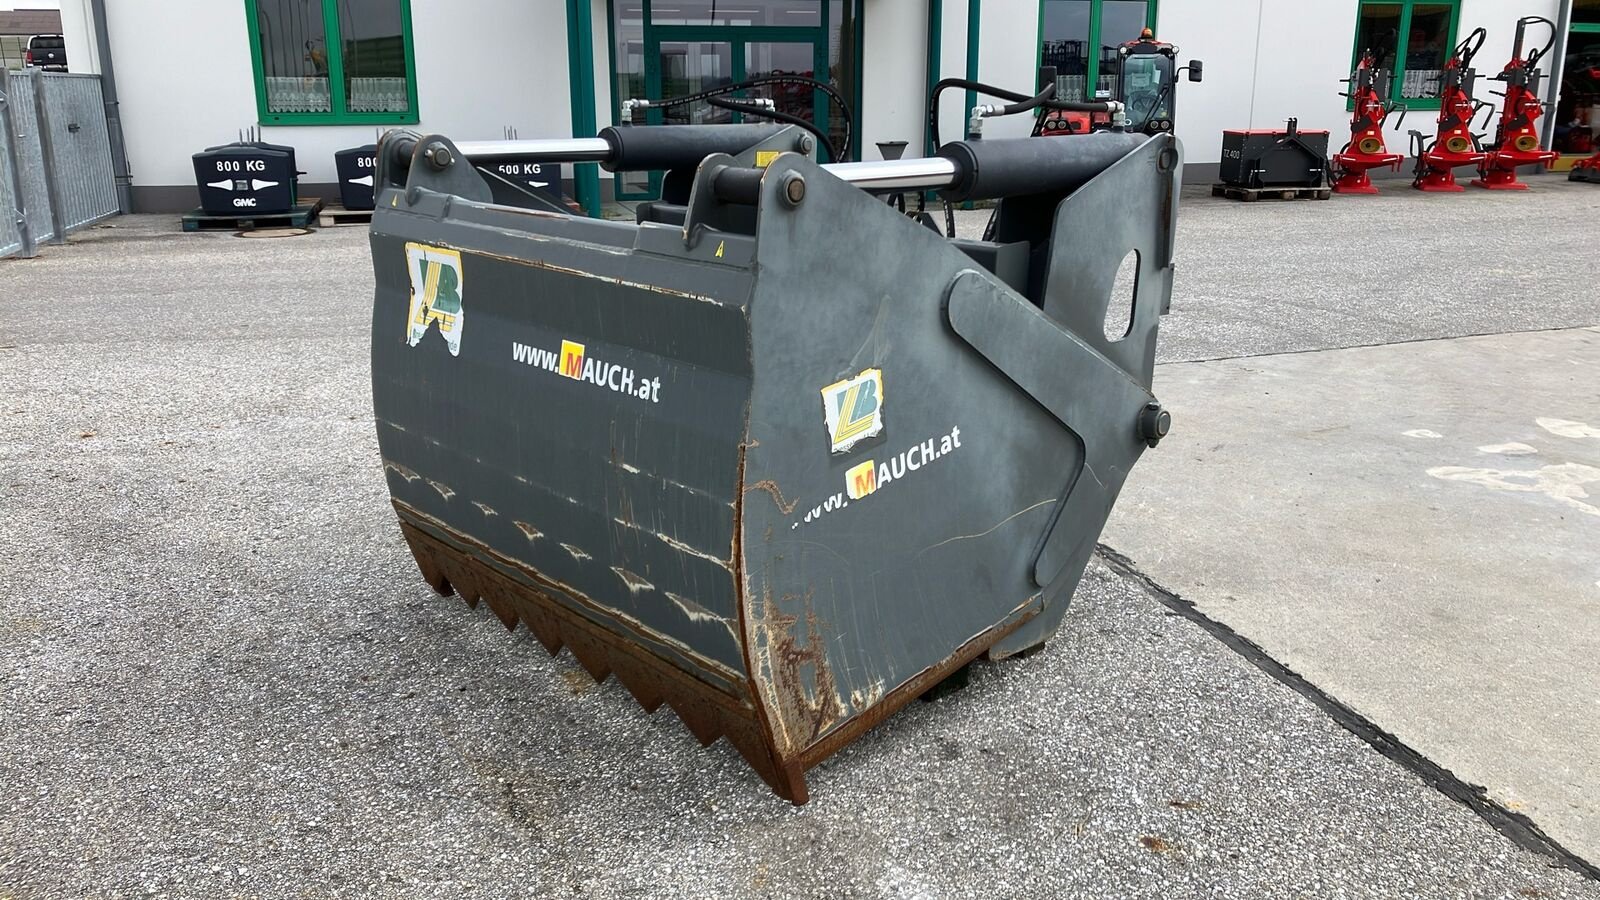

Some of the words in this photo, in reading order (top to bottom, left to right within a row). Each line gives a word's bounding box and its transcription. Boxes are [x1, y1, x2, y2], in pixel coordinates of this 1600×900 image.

[1230, 150, 1240, 159] 400
[216, 161, 240, 172] 800
[245, 160, 266, 171] KG
[498, 164, 519, 175] 500
[523, 163, 541, 174] KG
[232, 198, 257, 207] GMC
[512, 339, 661, 403] www.MAUCH.at
